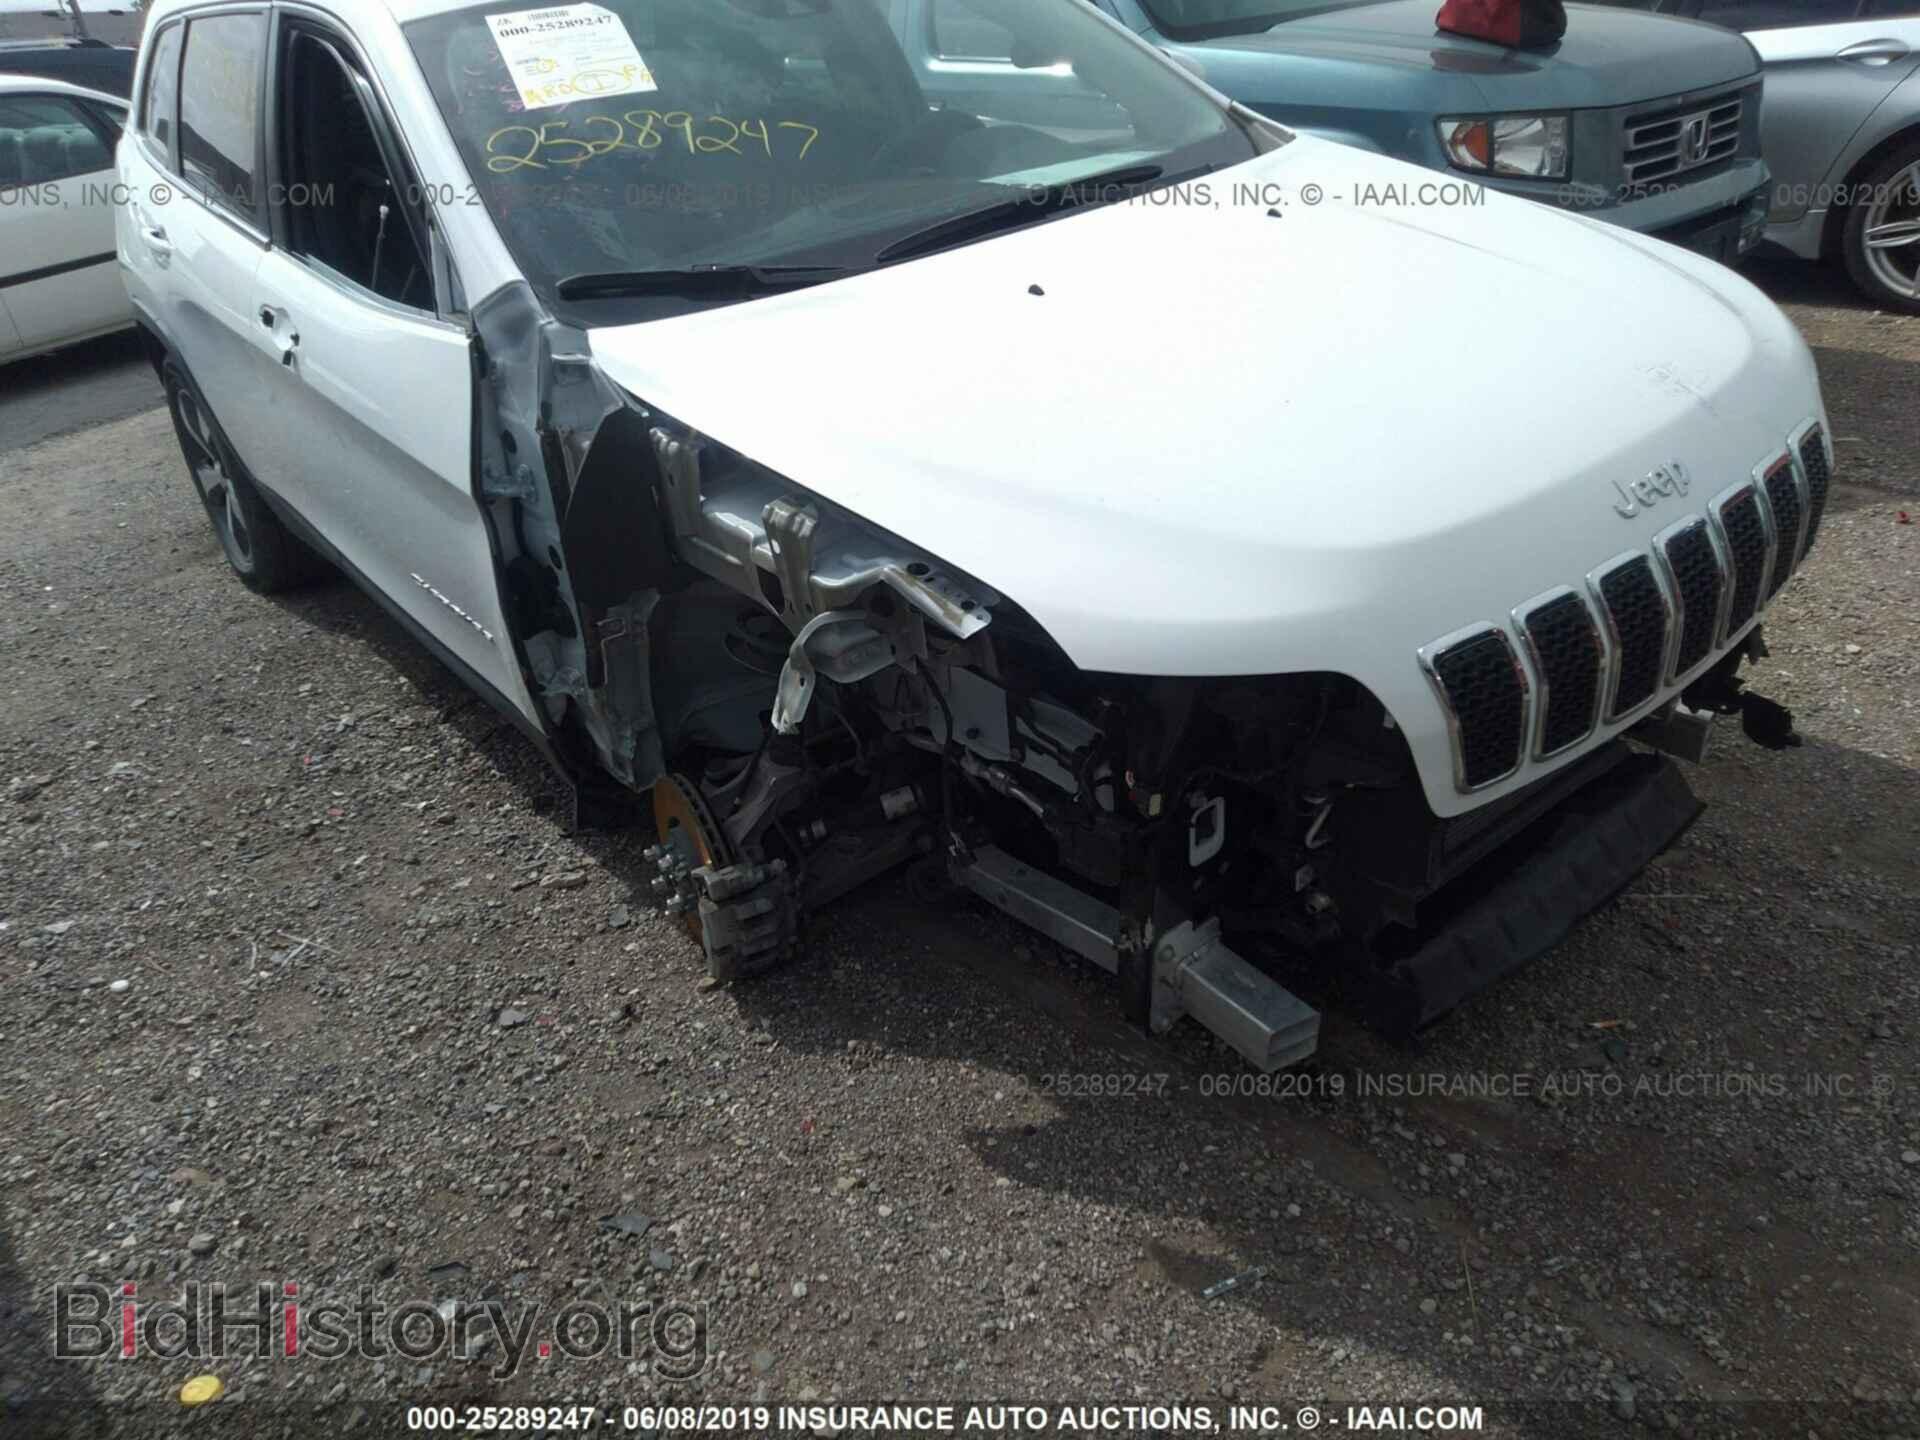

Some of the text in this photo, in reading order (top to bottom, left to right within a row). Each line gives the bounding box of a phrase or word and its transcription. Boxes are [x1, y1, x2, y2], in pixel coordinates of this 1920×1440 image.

[499, 15, 613, 38] 000-25289247
[487, 110, 818, 172] 25289247
[1611, 458, 1691, 519] Jeep
